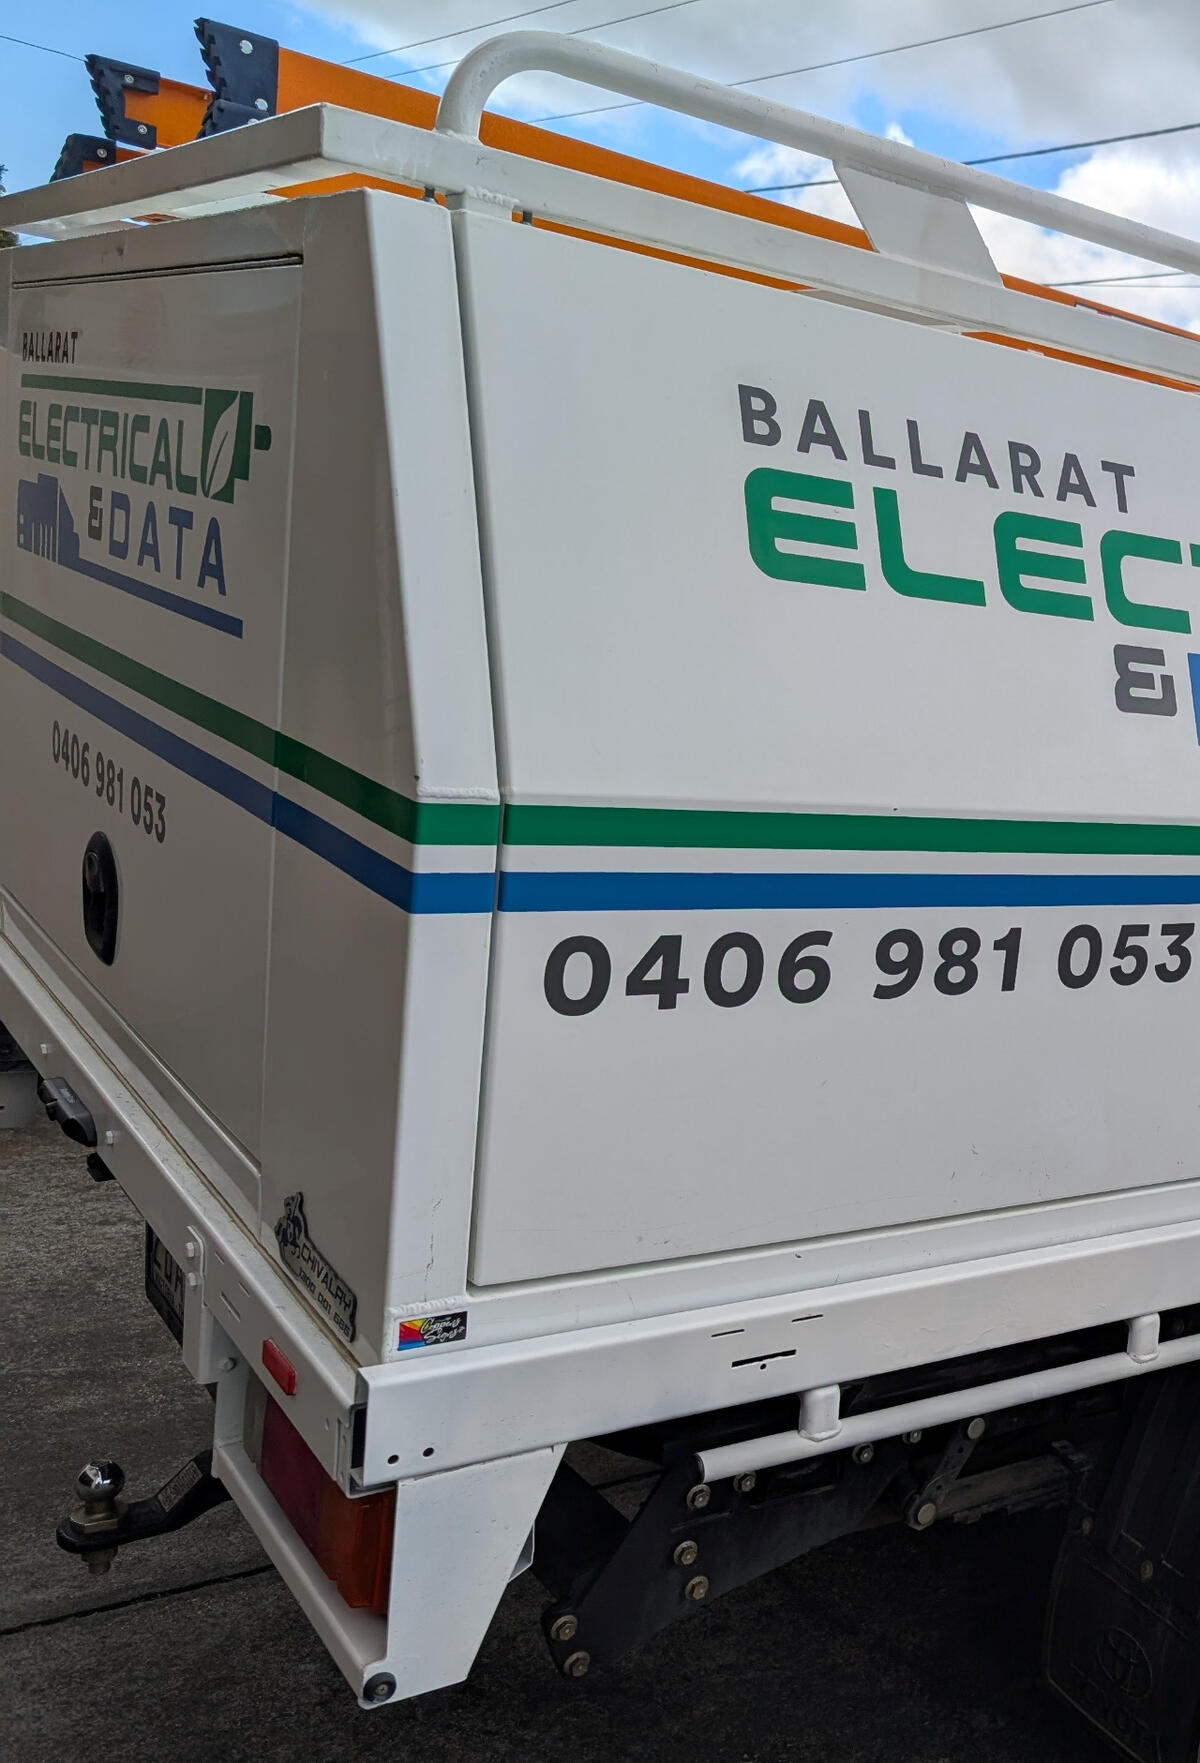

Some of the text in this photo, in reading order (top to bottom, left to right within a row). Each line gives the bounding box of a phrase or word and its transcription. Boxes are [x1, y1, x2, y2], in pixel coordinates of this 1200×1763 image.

[22, 331, 78, 364] BALLARAT
[19, 400, 198, 496] ELECTRICAL
[738, 384, 1135, 513] BALLARAT
[53, 720, 165, 843] 0406 981 053
[543, 923, 1196, 1017] 0406 981 053
[301, 1242, 352, 1312] CHIVALRY
